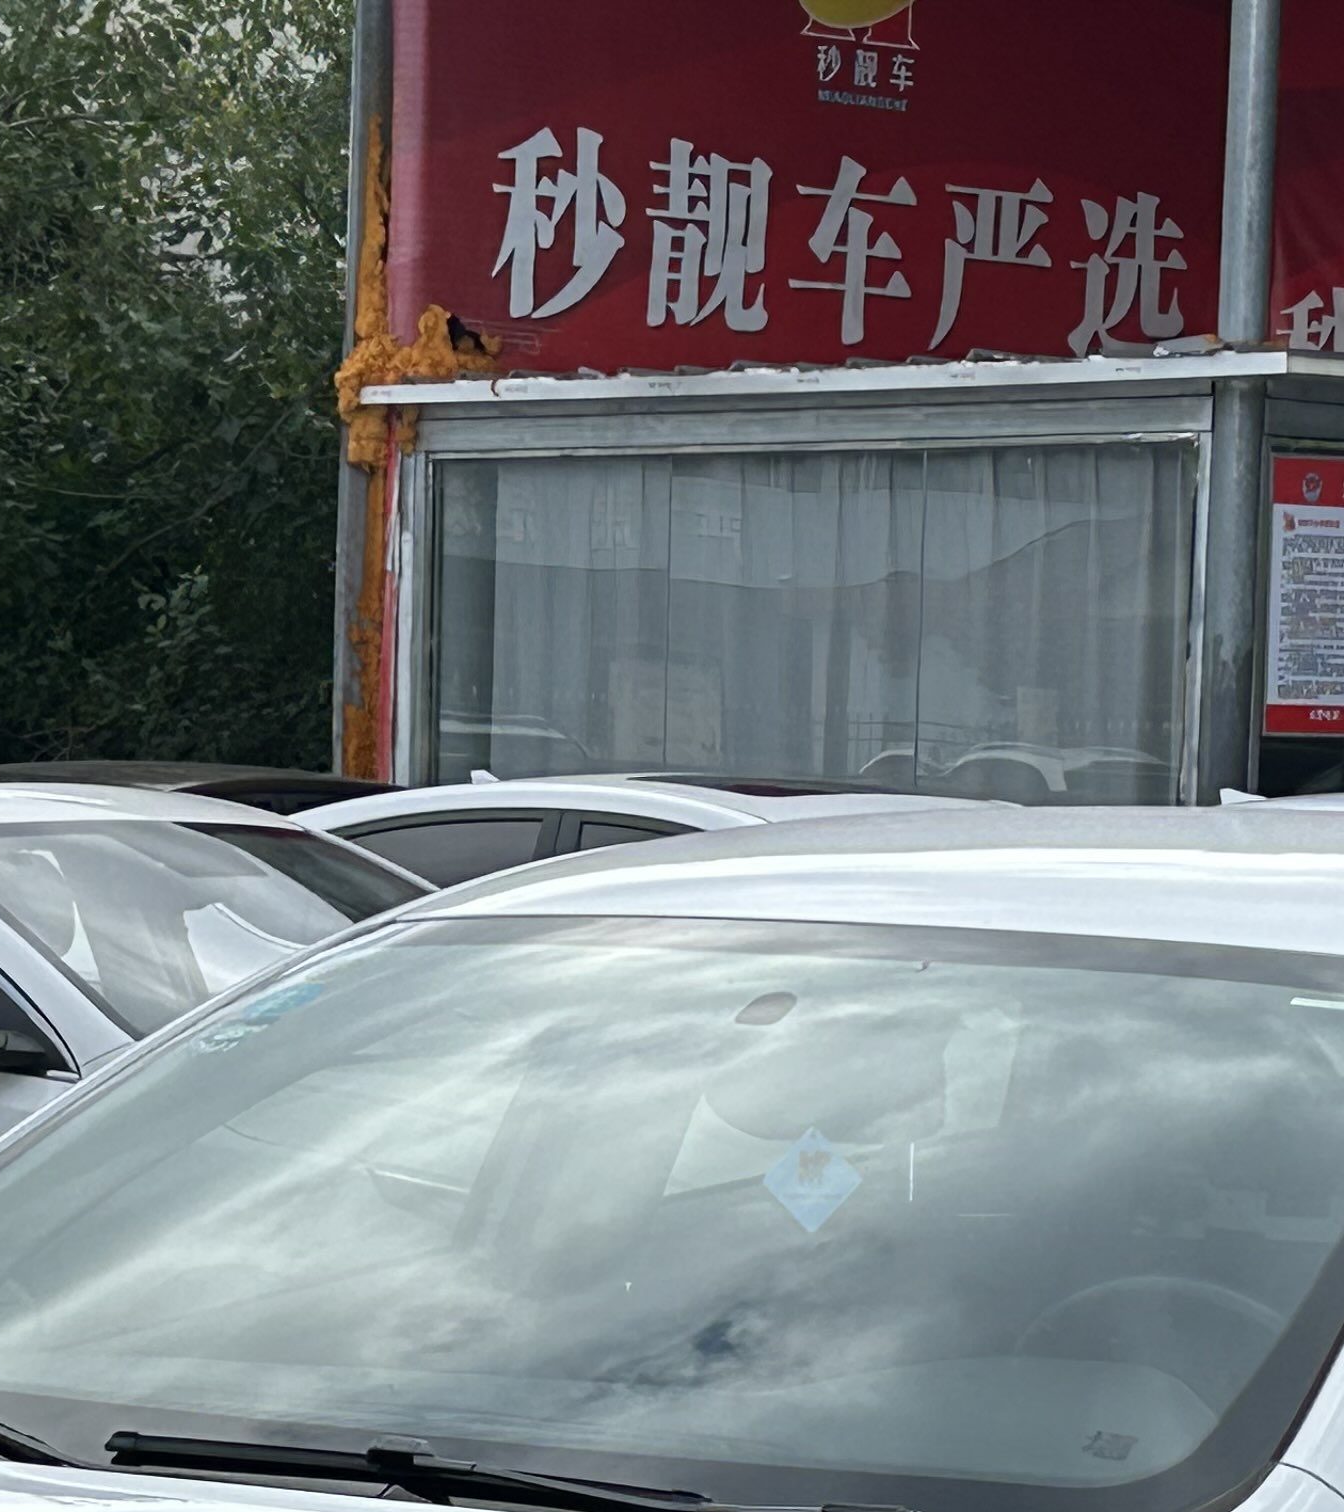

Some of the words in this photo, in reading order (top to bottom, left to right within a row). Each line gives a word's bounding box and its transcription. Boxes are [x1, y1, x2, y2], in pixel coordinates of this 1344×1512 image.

[491, 126, 1188, 358] 秒靓车严选
